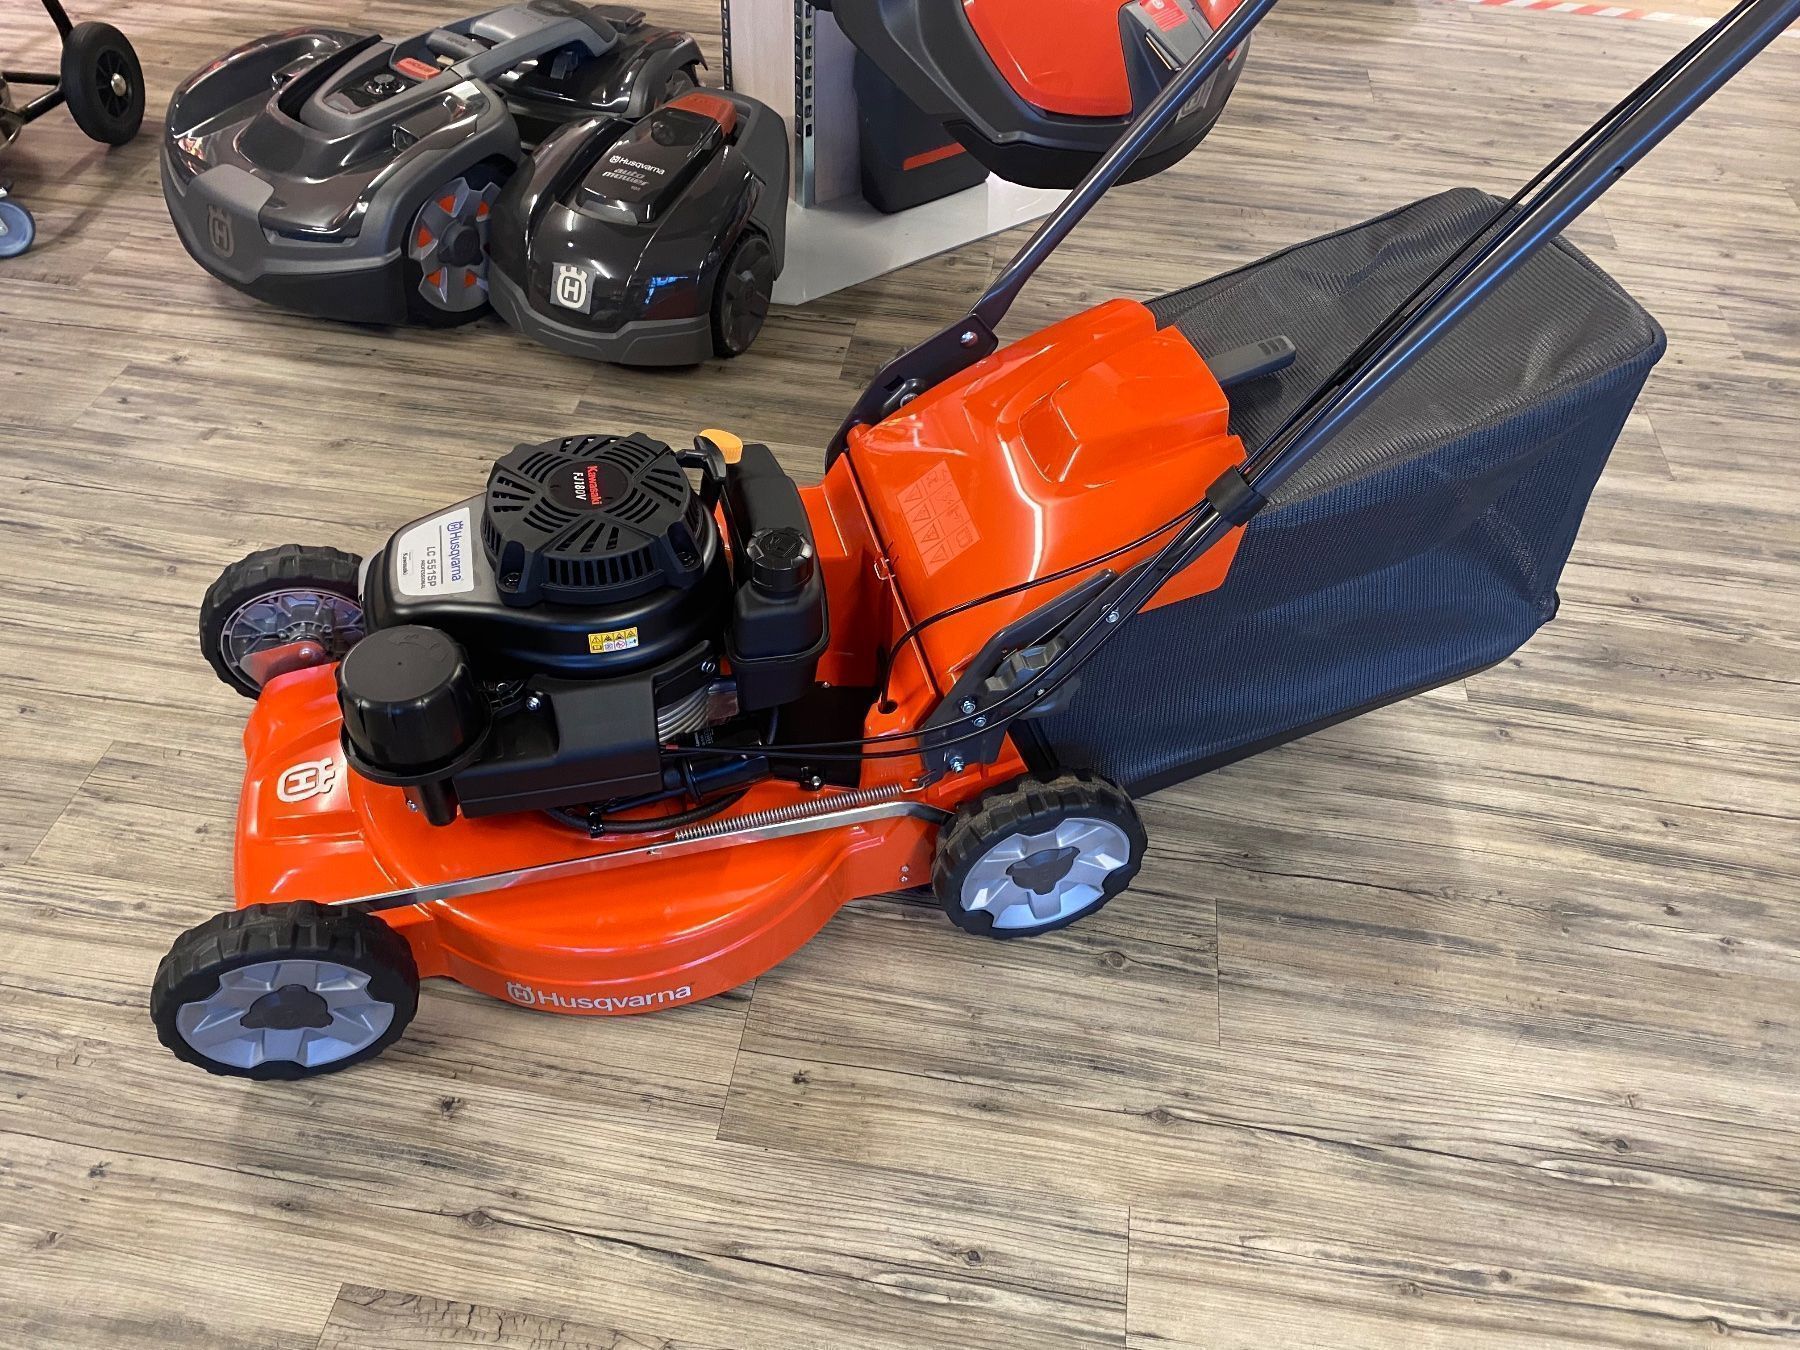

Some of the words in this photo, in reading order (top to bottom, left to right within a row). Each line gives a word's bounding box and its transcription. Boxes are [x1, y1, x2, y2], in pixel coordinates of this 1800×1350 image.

[613, 168, 646, 180] auto
[619, 156, 666, 176] Husqvarna
[573, 472, 587, 501] FJ180V
[587, 465, 603, 505] Kawasaki
[426, 546, 436, 557] LC
[448, 531, 463, 582] Husqvarna
[427, 559, 437, 587] 551SP
[538, 985, 692, 1012] Husqvarna
